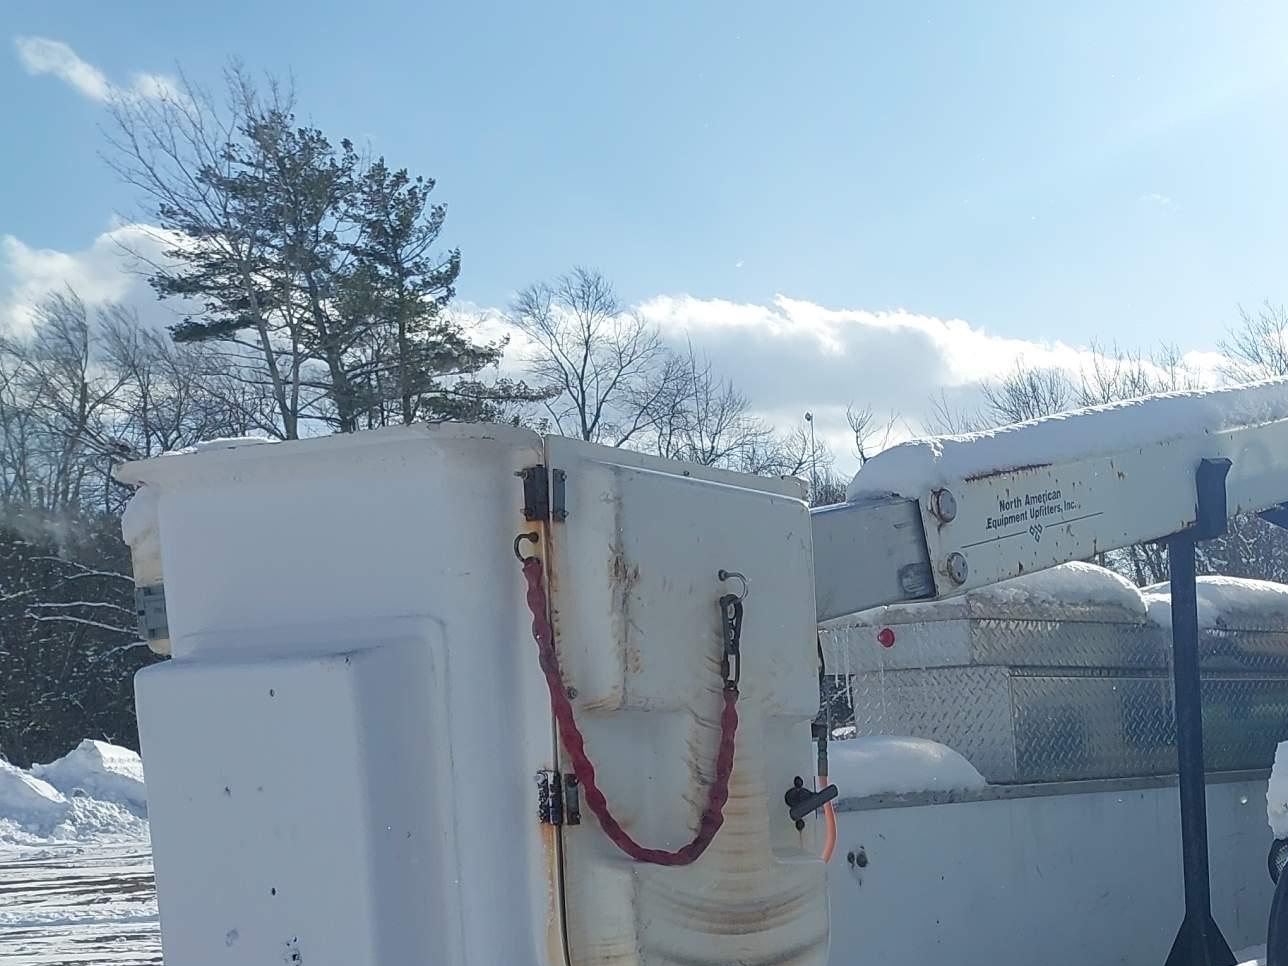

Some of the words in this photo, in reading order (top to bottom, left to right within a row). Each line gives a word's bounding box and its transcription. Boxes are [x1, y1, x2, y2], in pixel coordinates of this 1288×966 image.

[999, 496, 1022, 512] North
[1025, 490, 1061, 505] American
[986, 509, 1028, 529] Equipment
[1064, 500, 1077, 511] Inc.
